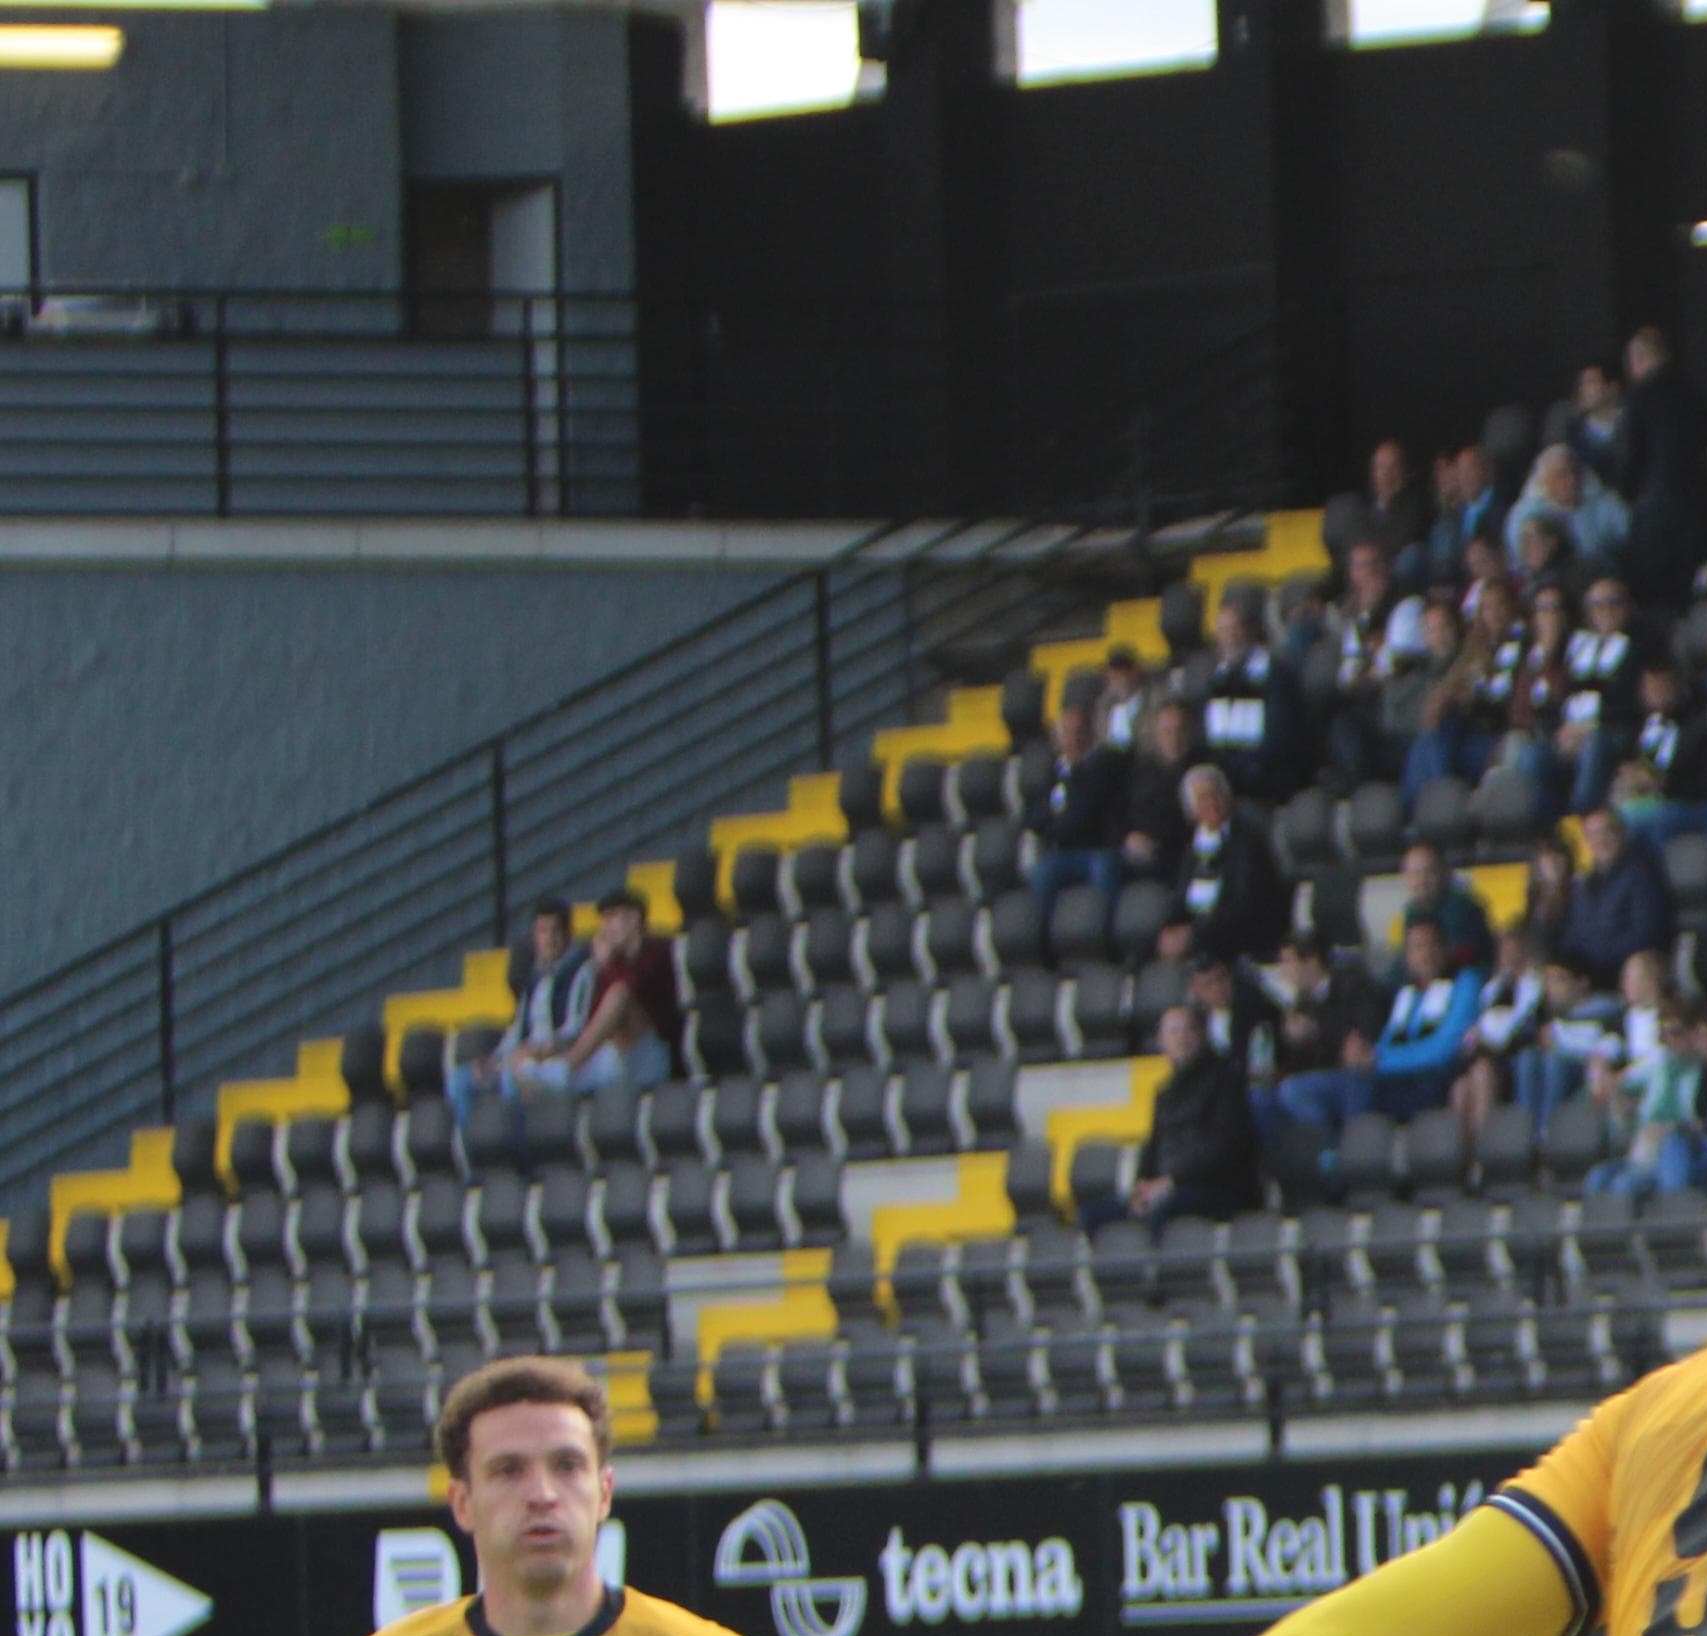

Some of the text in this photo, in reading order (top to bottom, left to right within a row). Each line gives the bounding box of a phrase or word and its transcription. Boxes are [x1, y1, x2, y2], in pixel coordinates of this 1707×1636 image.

[14, 1529, 74, 1612] HO
[879, 1527, 1082, 1625] tecna
[1117, 1479, 1484, 1599] Bar Real Uni
